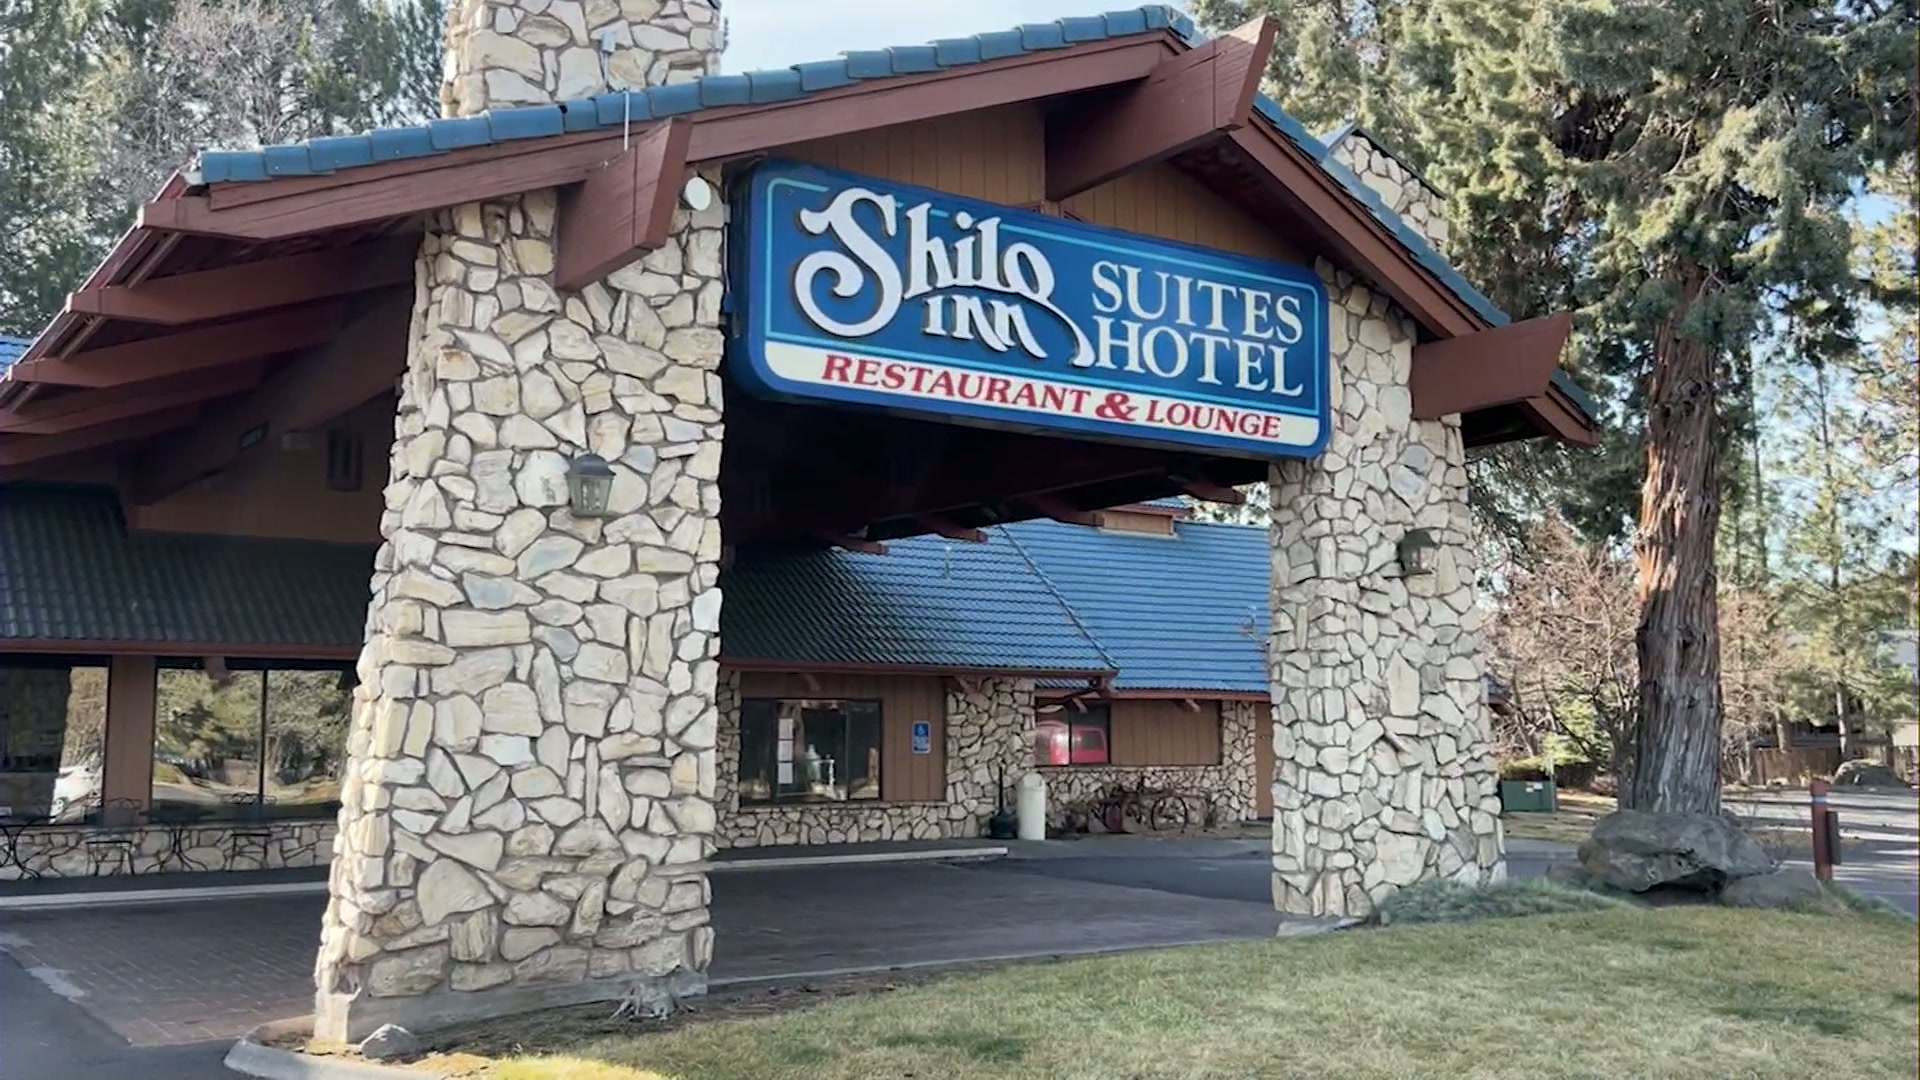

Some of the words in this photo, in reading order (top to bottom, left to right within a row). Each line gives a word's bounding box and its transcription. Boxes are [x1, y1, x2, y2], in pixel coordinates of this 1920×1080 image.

[795, 187, 1096, 367] Shilo
[1092, 261, 1303, 344] SUITES
[821, 354, 1091, 413] RESTAURANT
[1095, 392, 1138, 421] &
[1146, 399, 1281, 438] LOUNGE
[1092, 315, 1304, 397] HOTEL
